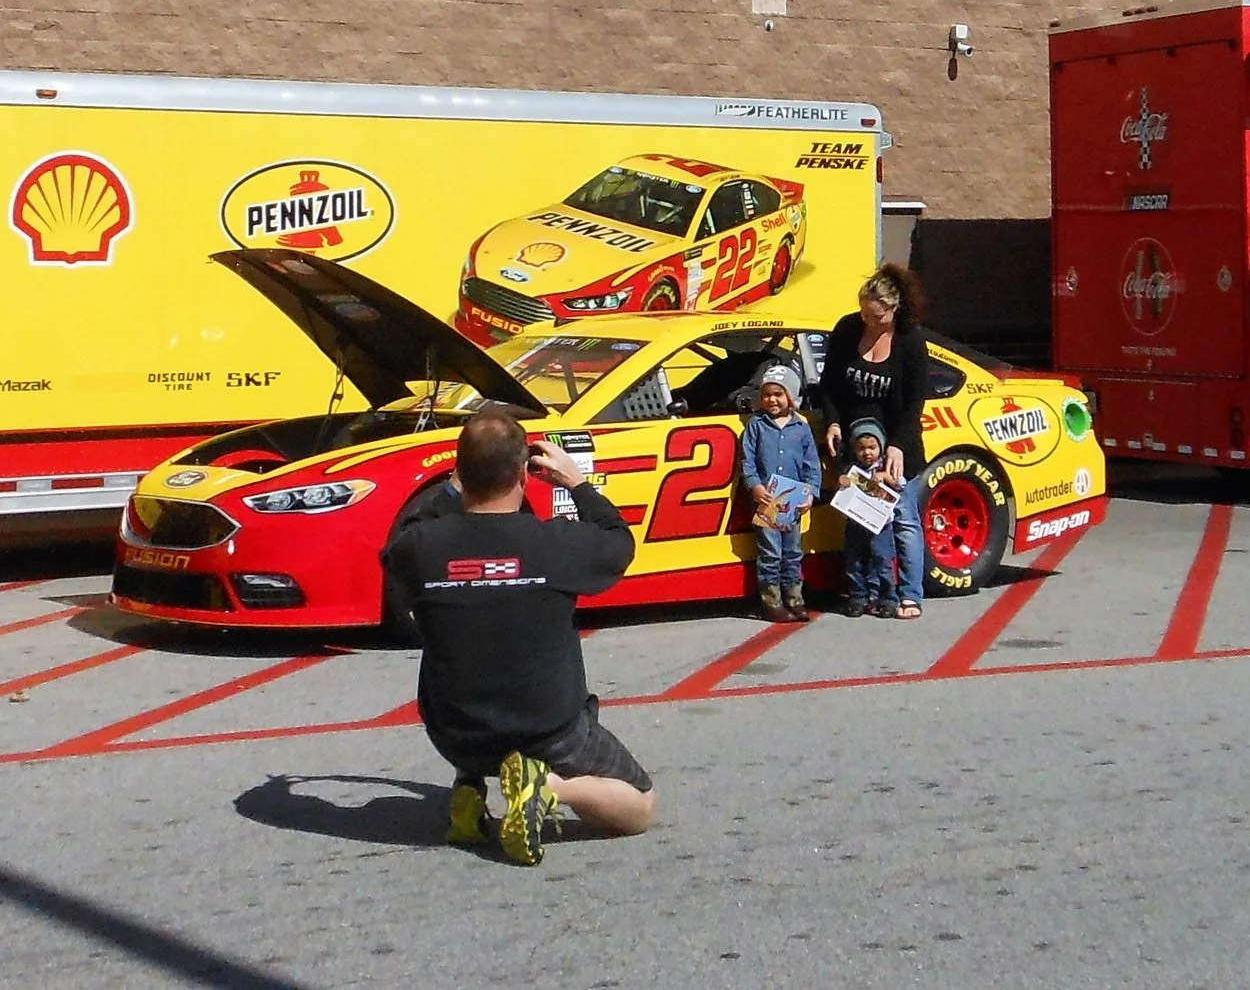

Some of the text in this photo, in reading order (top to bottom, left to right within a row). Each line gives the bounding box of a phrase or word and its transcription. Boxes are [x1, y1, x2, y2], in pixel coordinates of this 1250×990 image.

[757, 105, 848, 120] FEATHERLITE
[810, 142, 863, 155] TEAM
[795, 157, 869, 170] PENSKE
[247, 188, 369, 237] PENNZOIL
[761, 213, 787, 232] Shell
[527, 212, 655, 253] PENNZOIL
[708, 226, 757, 304] 22
[471, 307, 525, 335] FUSIO
[711, 320, 784, 331] JOEY LOGANO
[147, 372, 212, 384] DISCOUNT
[226, 371, 281, 388] SKF
[966, 383, 995, 395] SKF
[921, 406, 961, 431] ell
[983, 409, 1048, 442] PENNZOIL
[1025, 481, 1073, 506] Autotrader
[1026, 510, 1091, 542] Snap-on
[424, 576, 547, 589] SPORT DIMENSIONS
[930, 566, 972, 588] EAGLE
